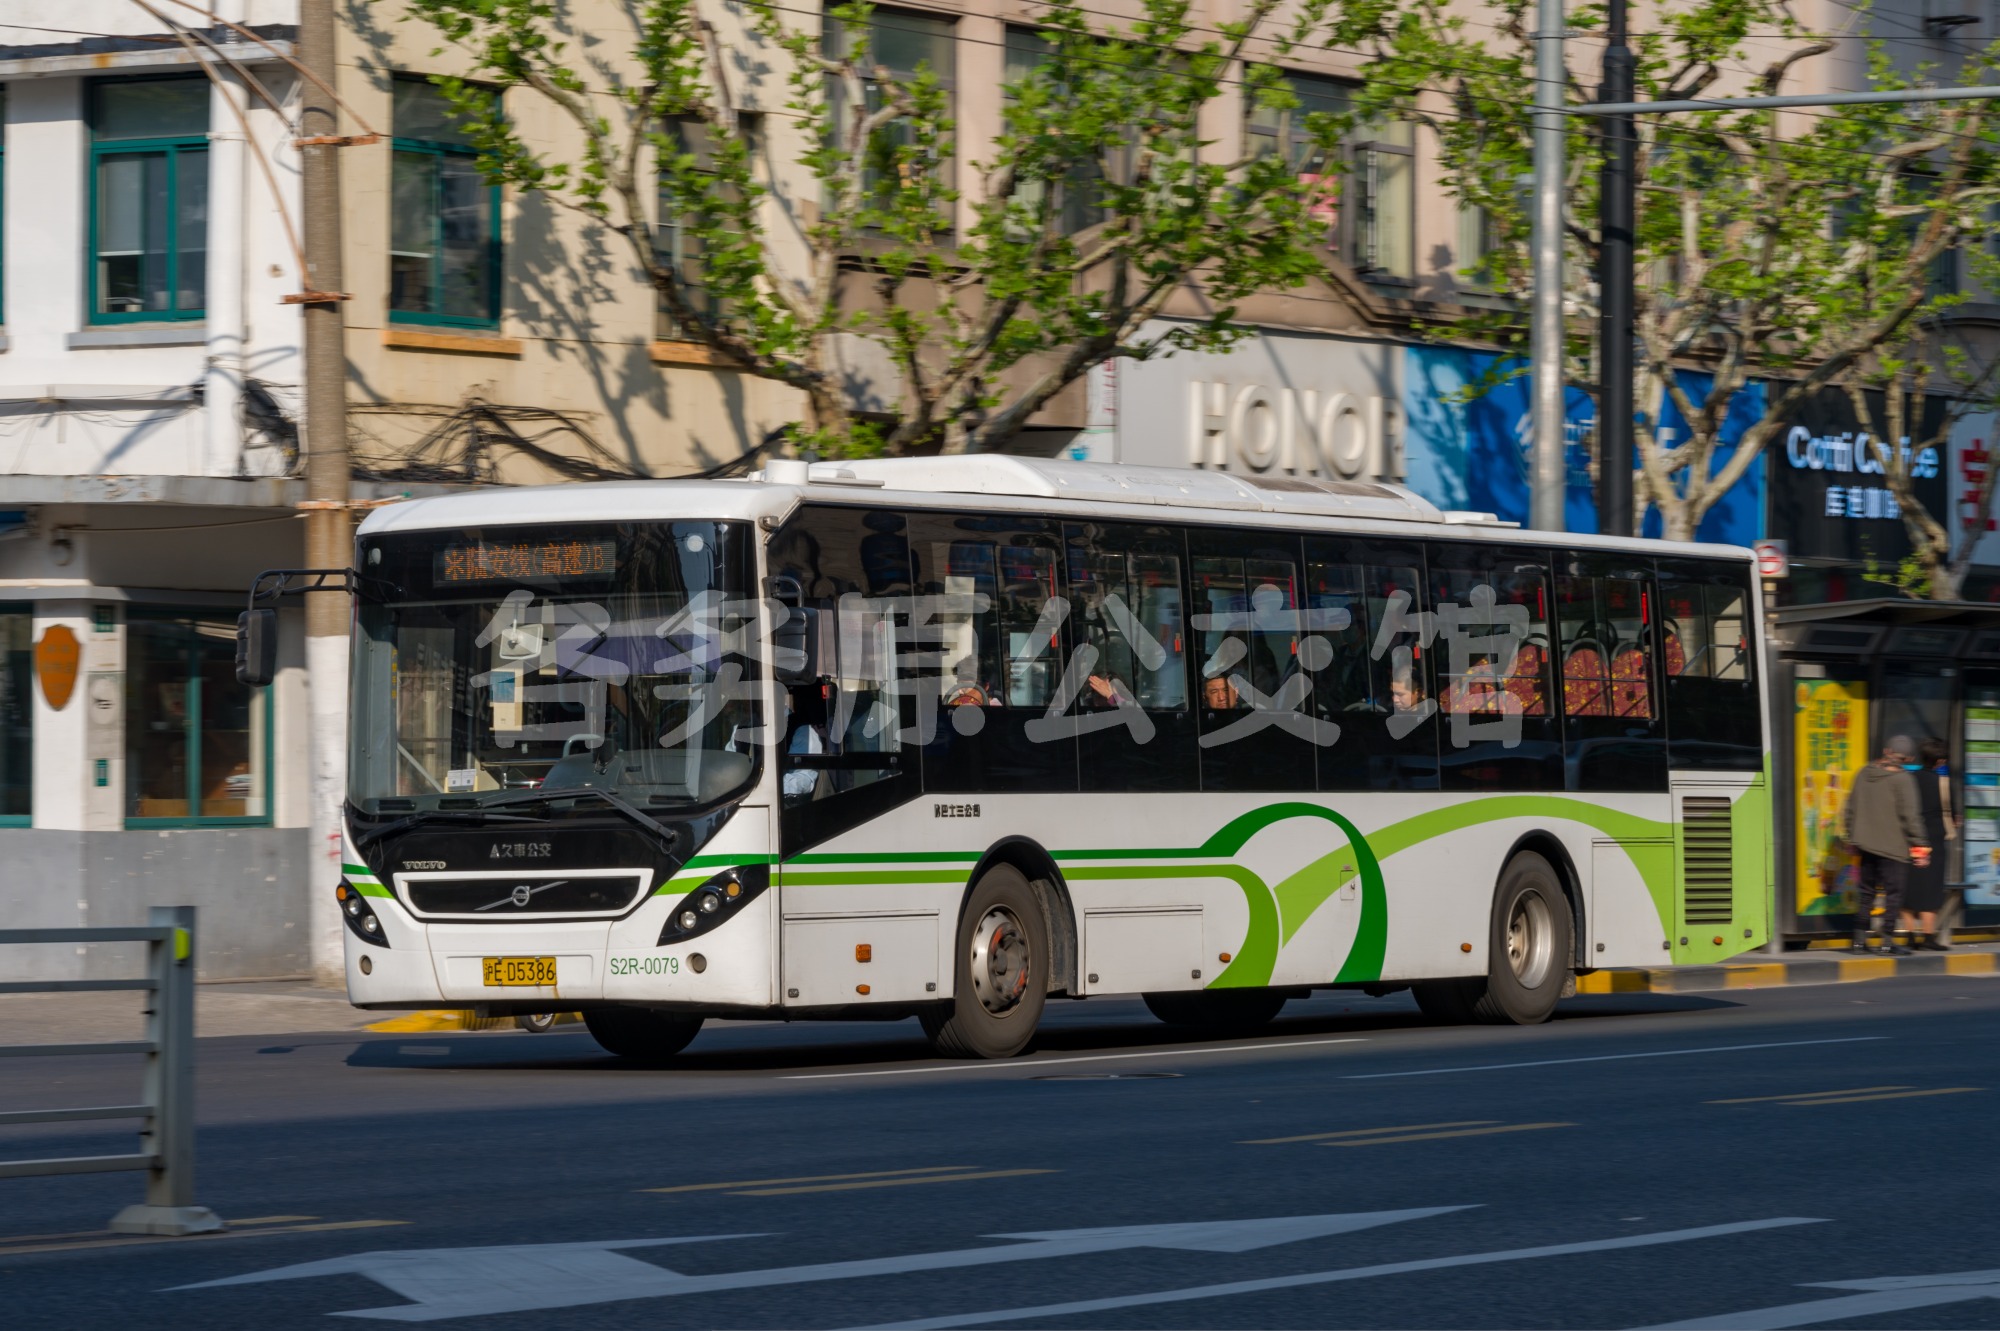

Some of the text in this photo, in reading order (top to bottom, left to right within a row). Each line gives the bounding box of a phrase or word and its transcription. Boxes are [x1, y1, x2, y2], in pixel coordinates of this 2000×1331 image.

[1189, 378, 1407, 482] HONOR
[1786, 425, 1853, 472] Cotti
[402, 860, 447, 870] VOLVO
[610, 957, 679, 975] S2R-0079
